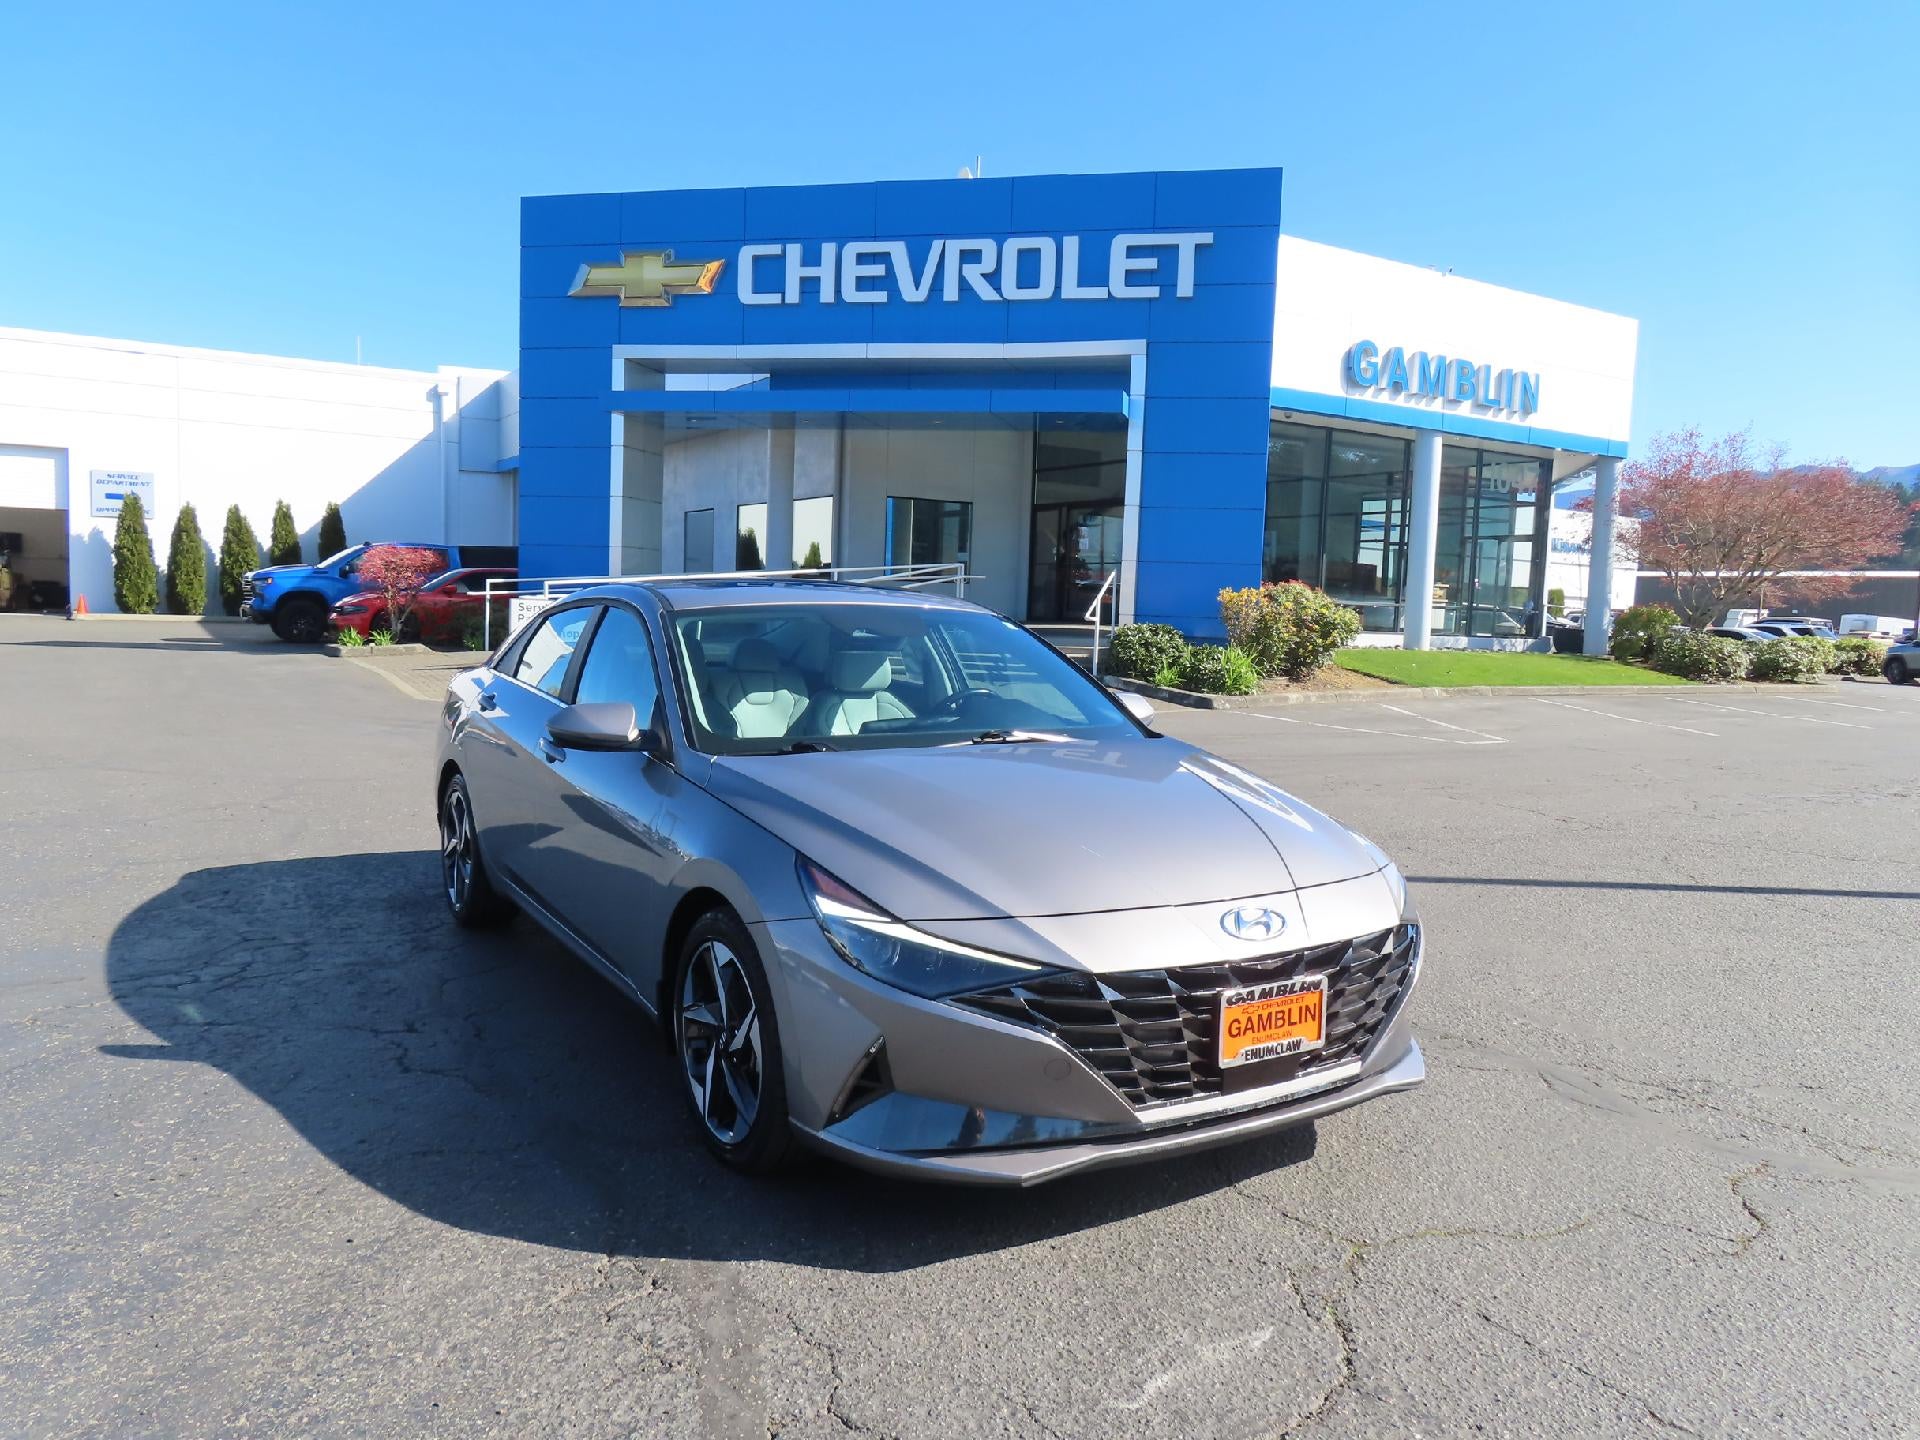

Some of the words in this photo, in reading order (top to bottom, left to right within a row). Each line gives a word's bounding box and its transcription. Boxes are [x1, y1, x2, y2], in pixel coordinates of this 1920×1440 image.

[736, 231, 1214, 304] CHEVROLET
[1341, 340, 1540, 414] GAMBLIN
[95, 479, 152, 487] DEPARTMENT
[518, 602, 550, 612] Serv
[1226, 979, 1323, 1006] GAMBLIN
[1261, 996, 1305, 1011] CHEVROLET
[1228, 1003, 1317, 1038] GAMBLIN
[1251, 1029, 1293, 1045] ENUMCLAW
[1244, 1038, 1302, 1061] ENUMCLAW
